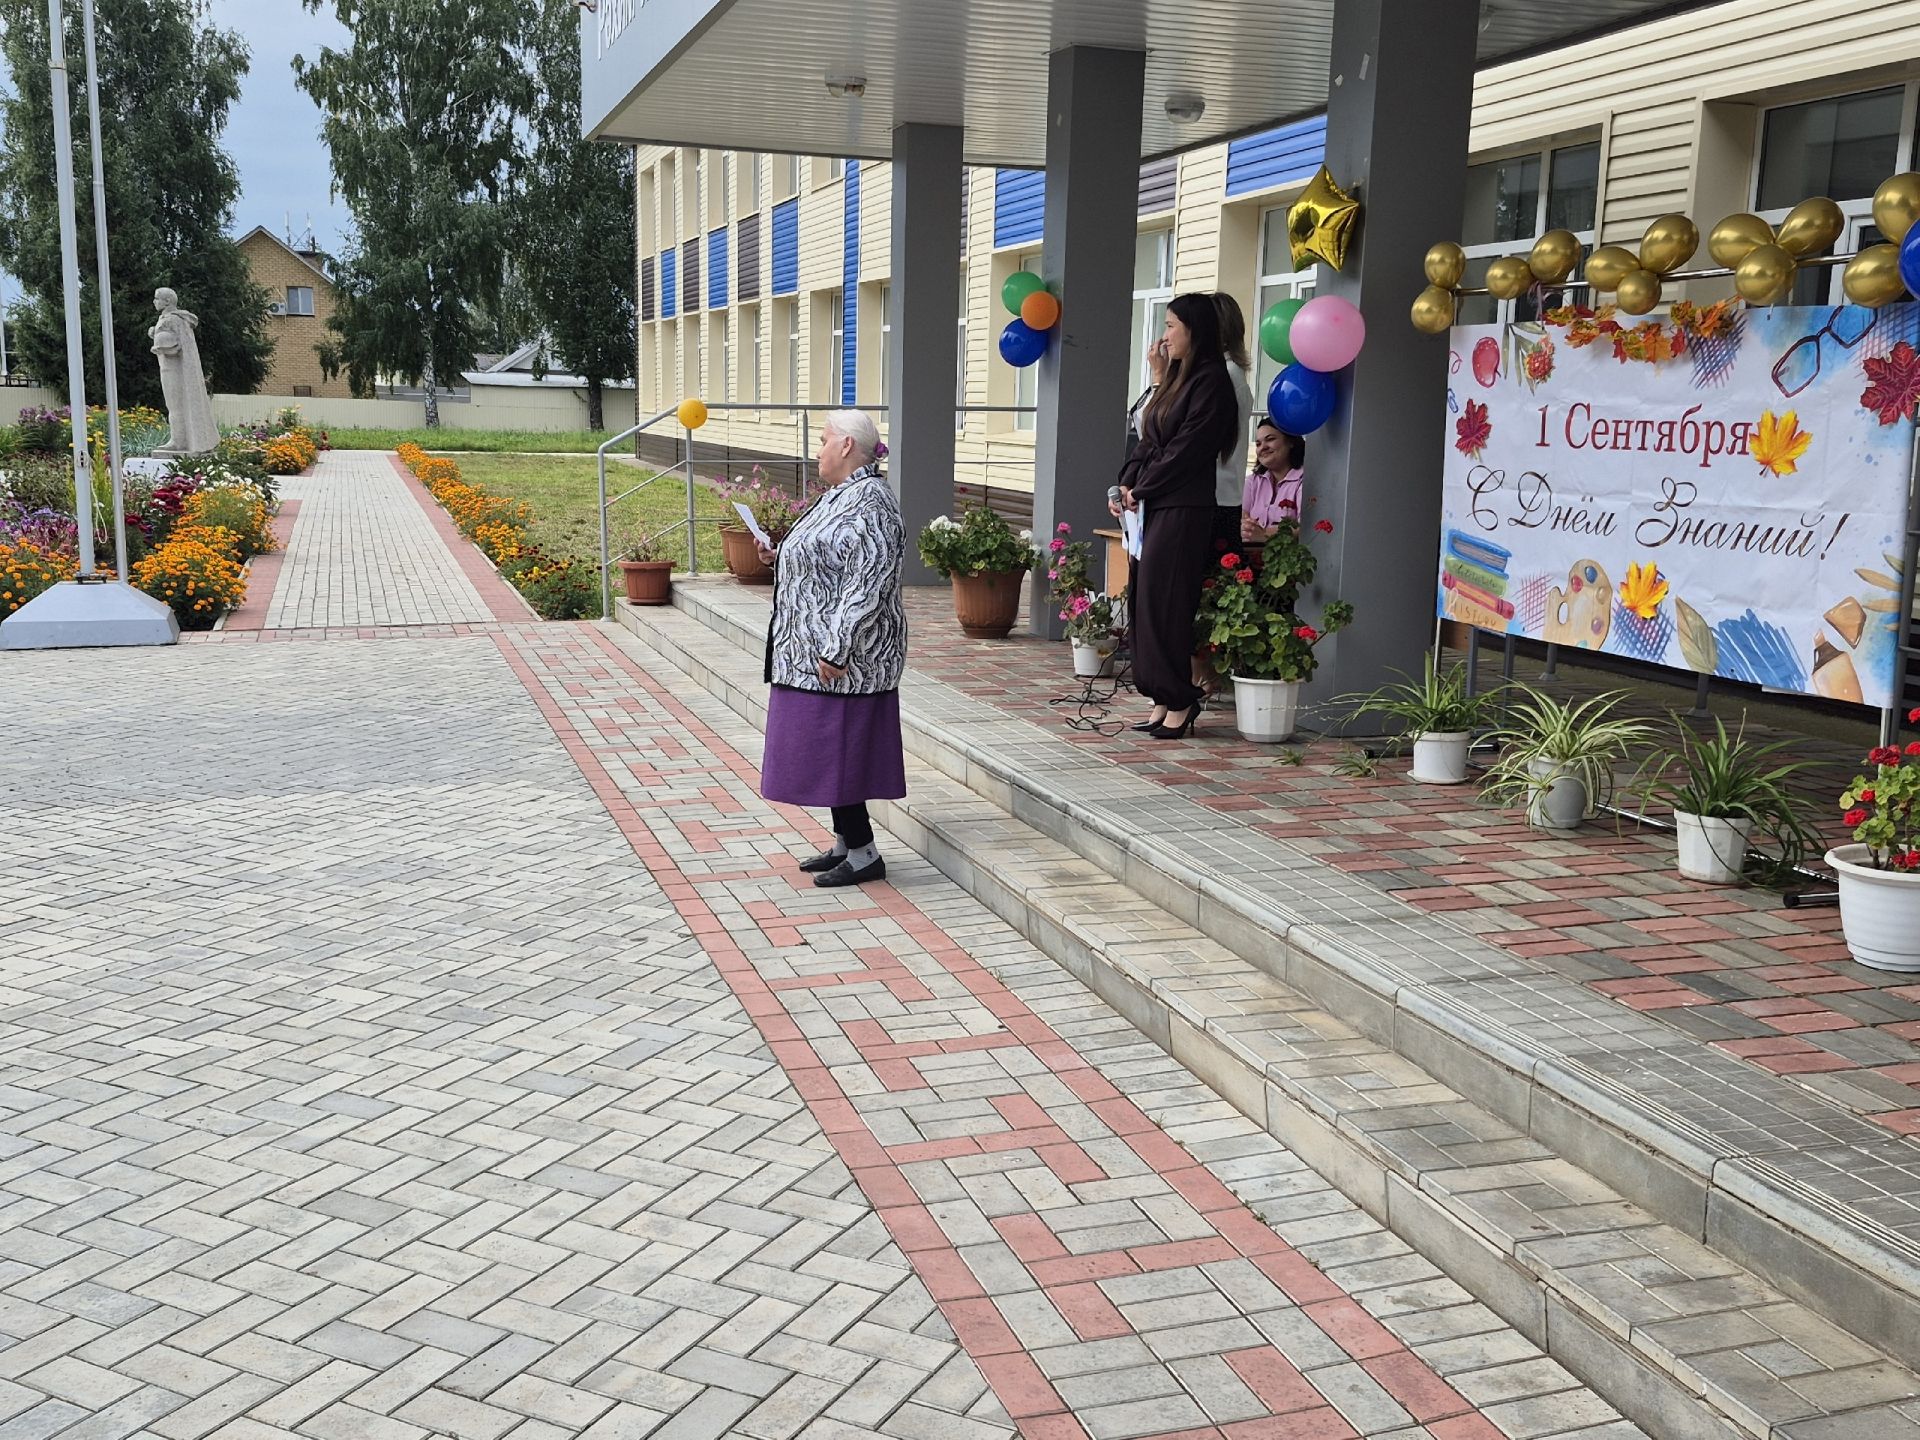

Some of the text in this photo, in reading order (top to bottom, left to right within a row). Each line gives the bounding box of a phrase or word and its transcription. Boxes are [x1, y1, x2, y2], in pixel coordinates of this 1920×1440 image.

[1535, 402, 1753, 468] 1 Сентября
[1466, 465, 1851, 560] С Днём Знаний!
